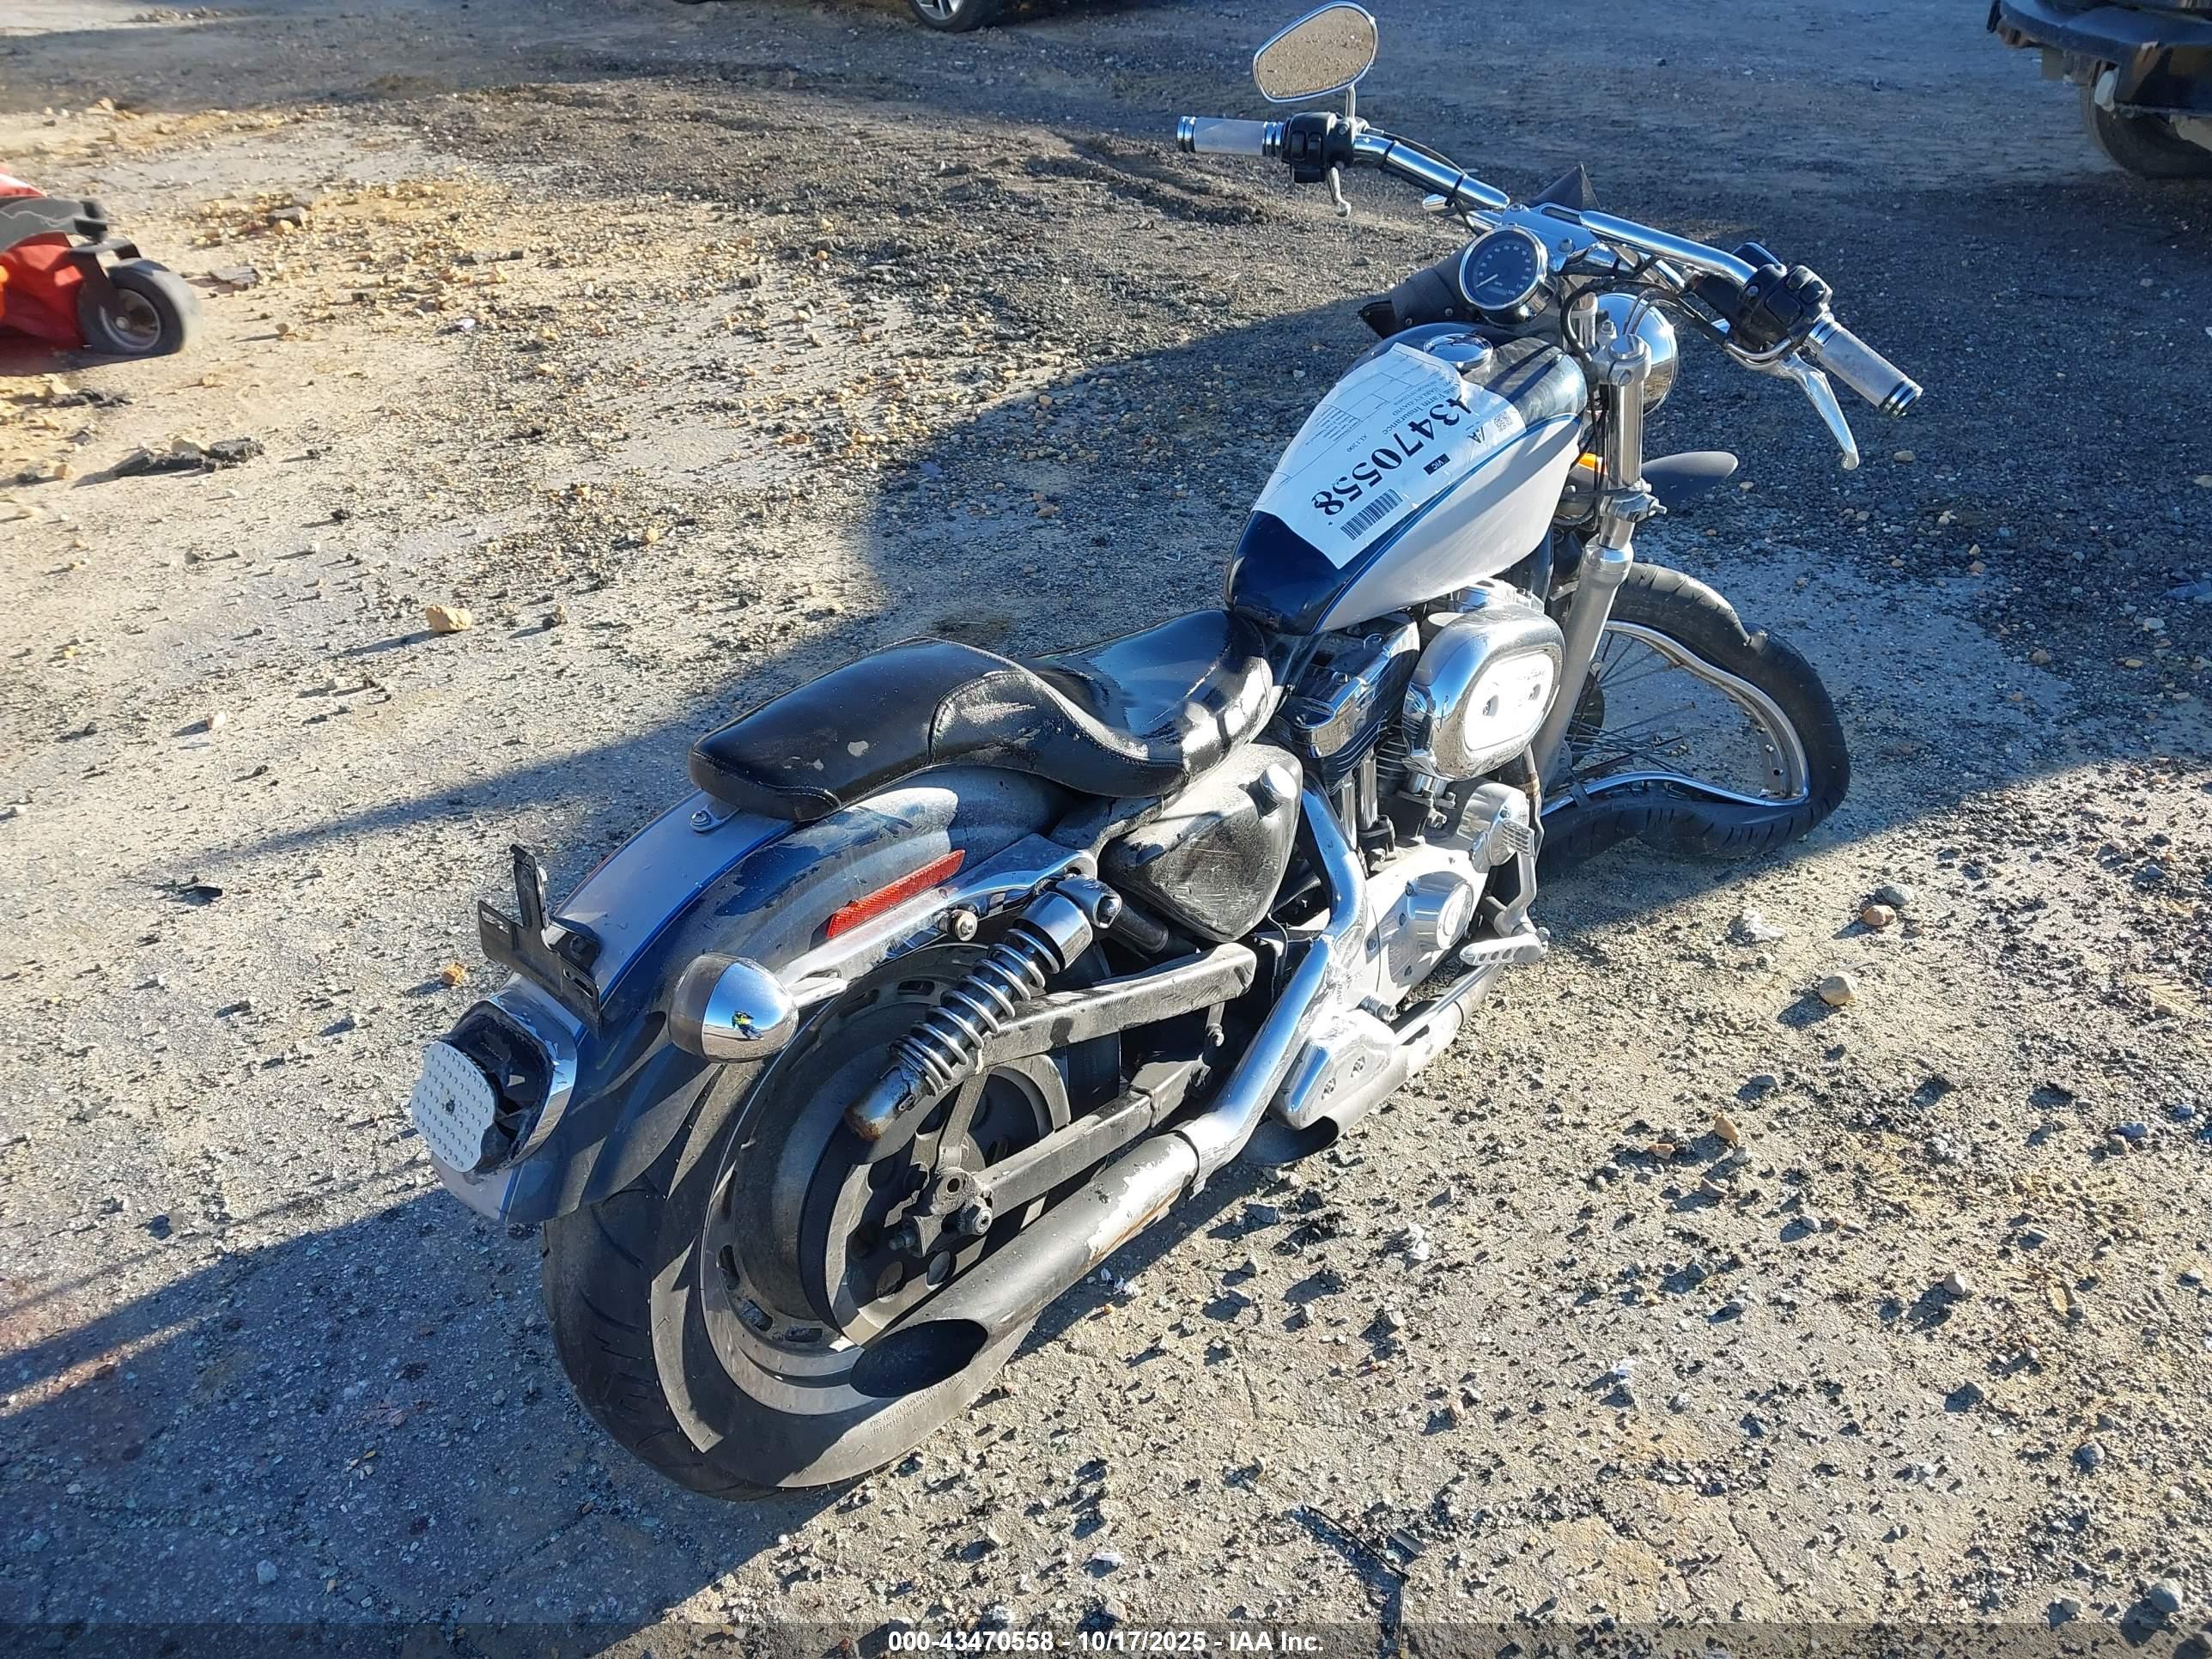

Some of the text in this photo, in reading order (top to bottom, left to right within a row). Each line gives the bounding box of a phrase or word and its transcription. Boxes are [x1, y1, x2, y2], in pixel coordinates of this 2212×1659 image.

[1425, 393, 1446, 407] Farm
[1382, 404, 1424, 435] Insurance
[1346, 434, 1368, 453] XL1200
[1311, 394, 1472, 514] 43470558
[1431, 459, 1444, 470] VIC
